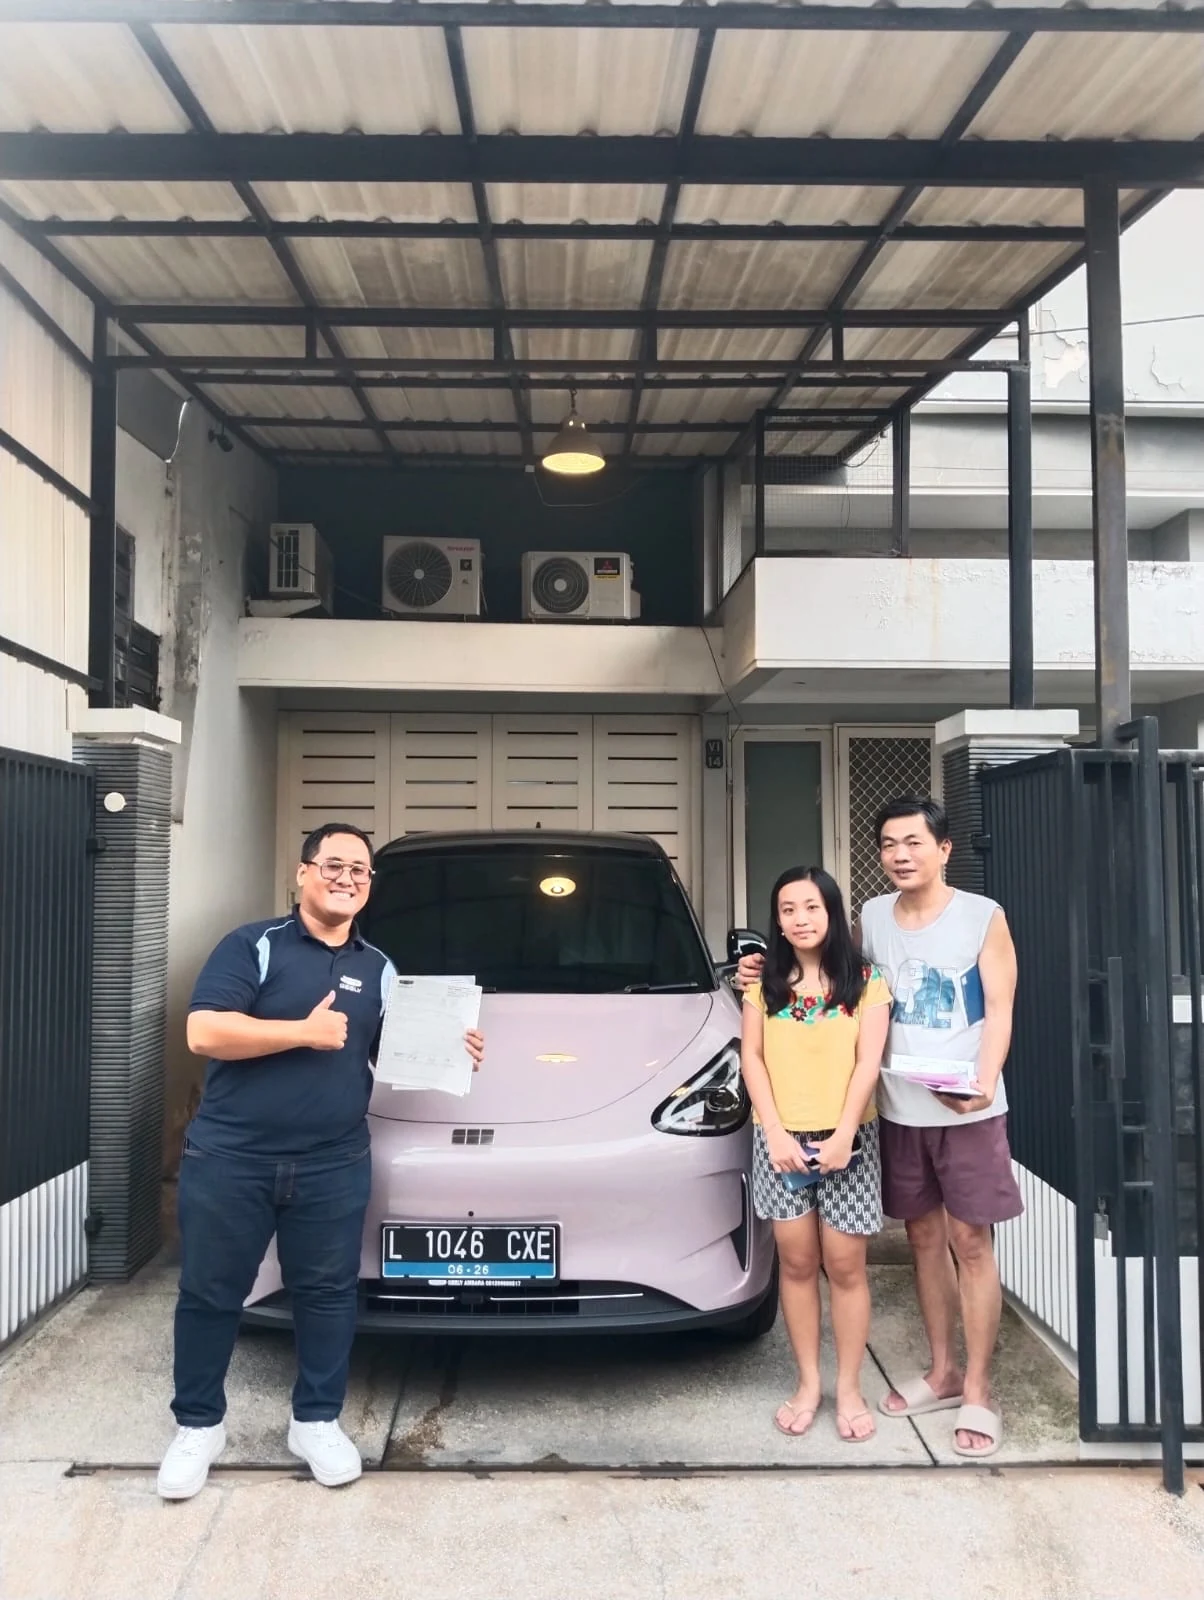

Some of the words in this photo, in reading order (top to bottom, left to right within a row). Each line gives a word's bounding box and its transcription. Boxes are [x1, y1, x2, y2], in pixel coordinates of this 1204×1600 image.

[708, 756, 721, 767] 14
[389, 1230, 402, 1259] L
[426, 1230, 484, 1259] 1046
[507, 1231, 550, 1260] CXE
